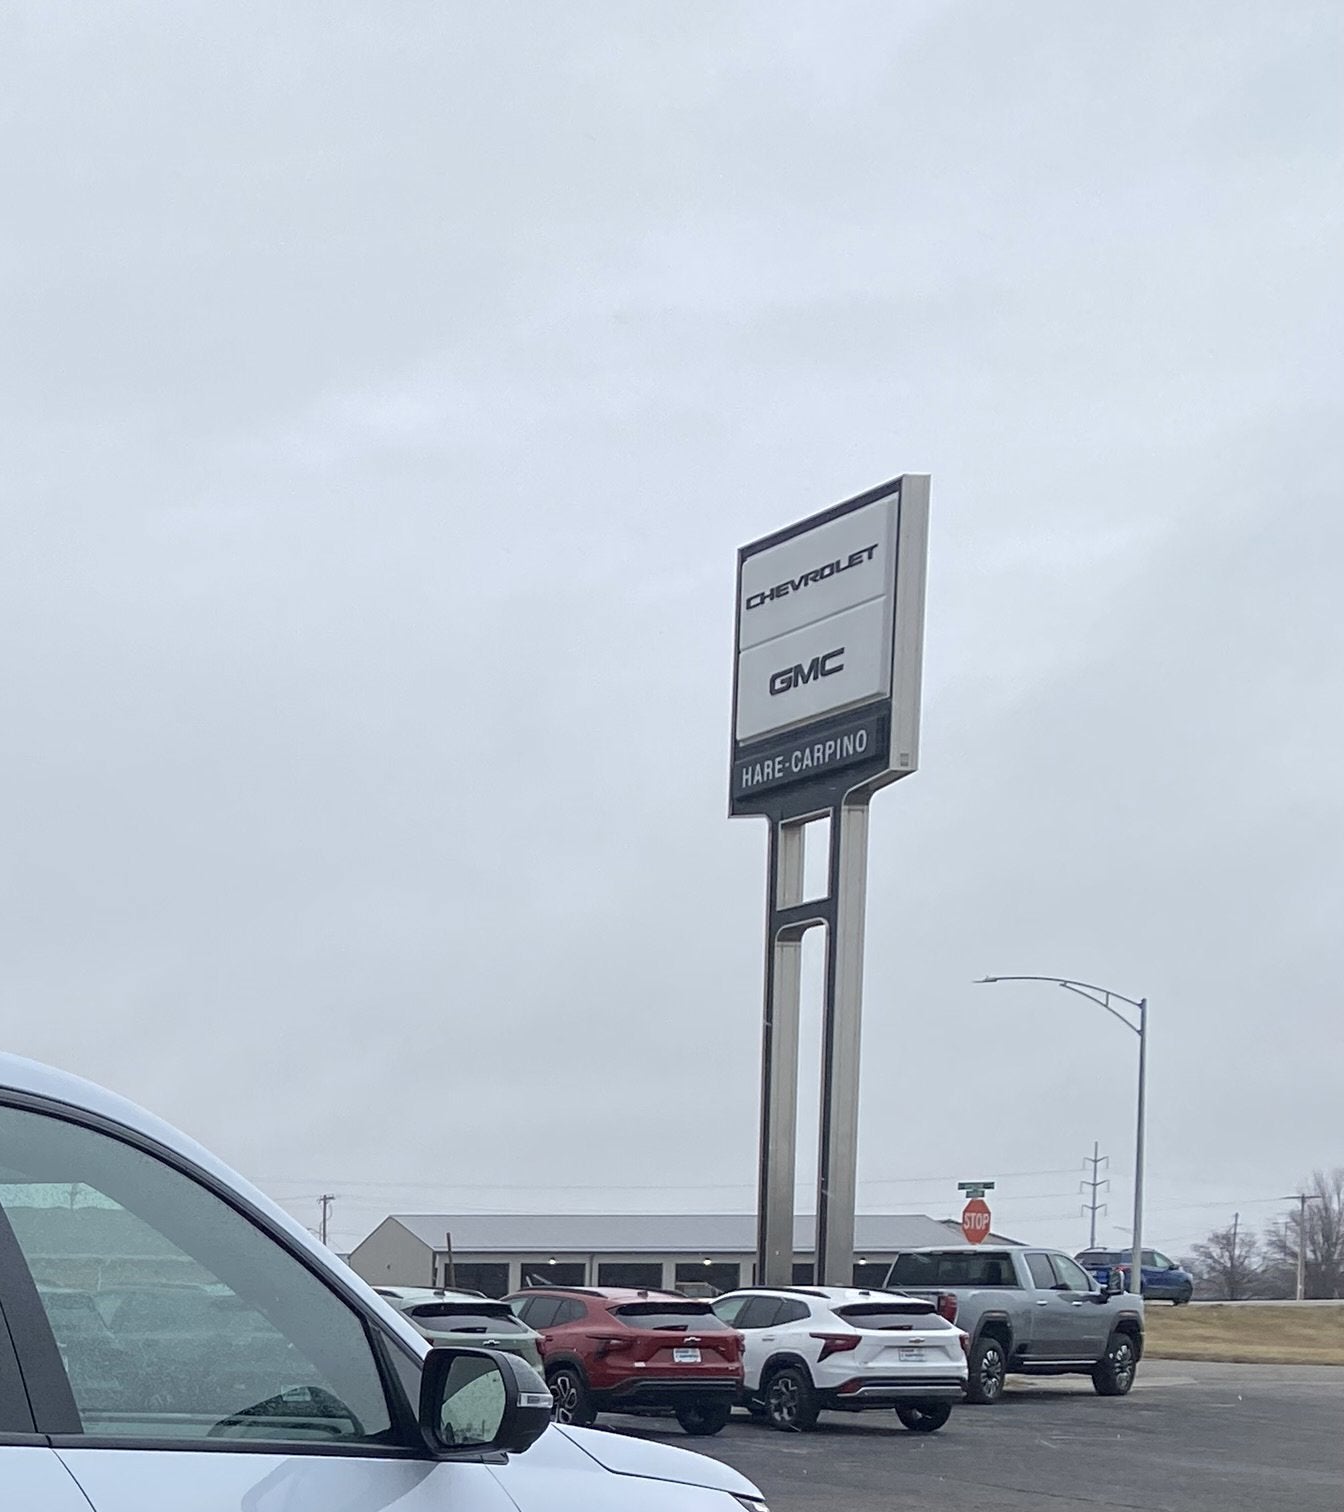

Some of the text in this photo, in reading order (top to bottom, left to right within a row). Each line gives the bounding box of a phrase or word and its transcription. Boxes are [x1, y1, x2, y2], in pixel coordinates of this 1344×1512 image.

[745, 543, 879, 611] CHEVROLET
[769, 647, 845, 696] GMC
[742, 729, 868, 788] HARE-CARPINO
[964, 1212, 990, 1230] STOP
